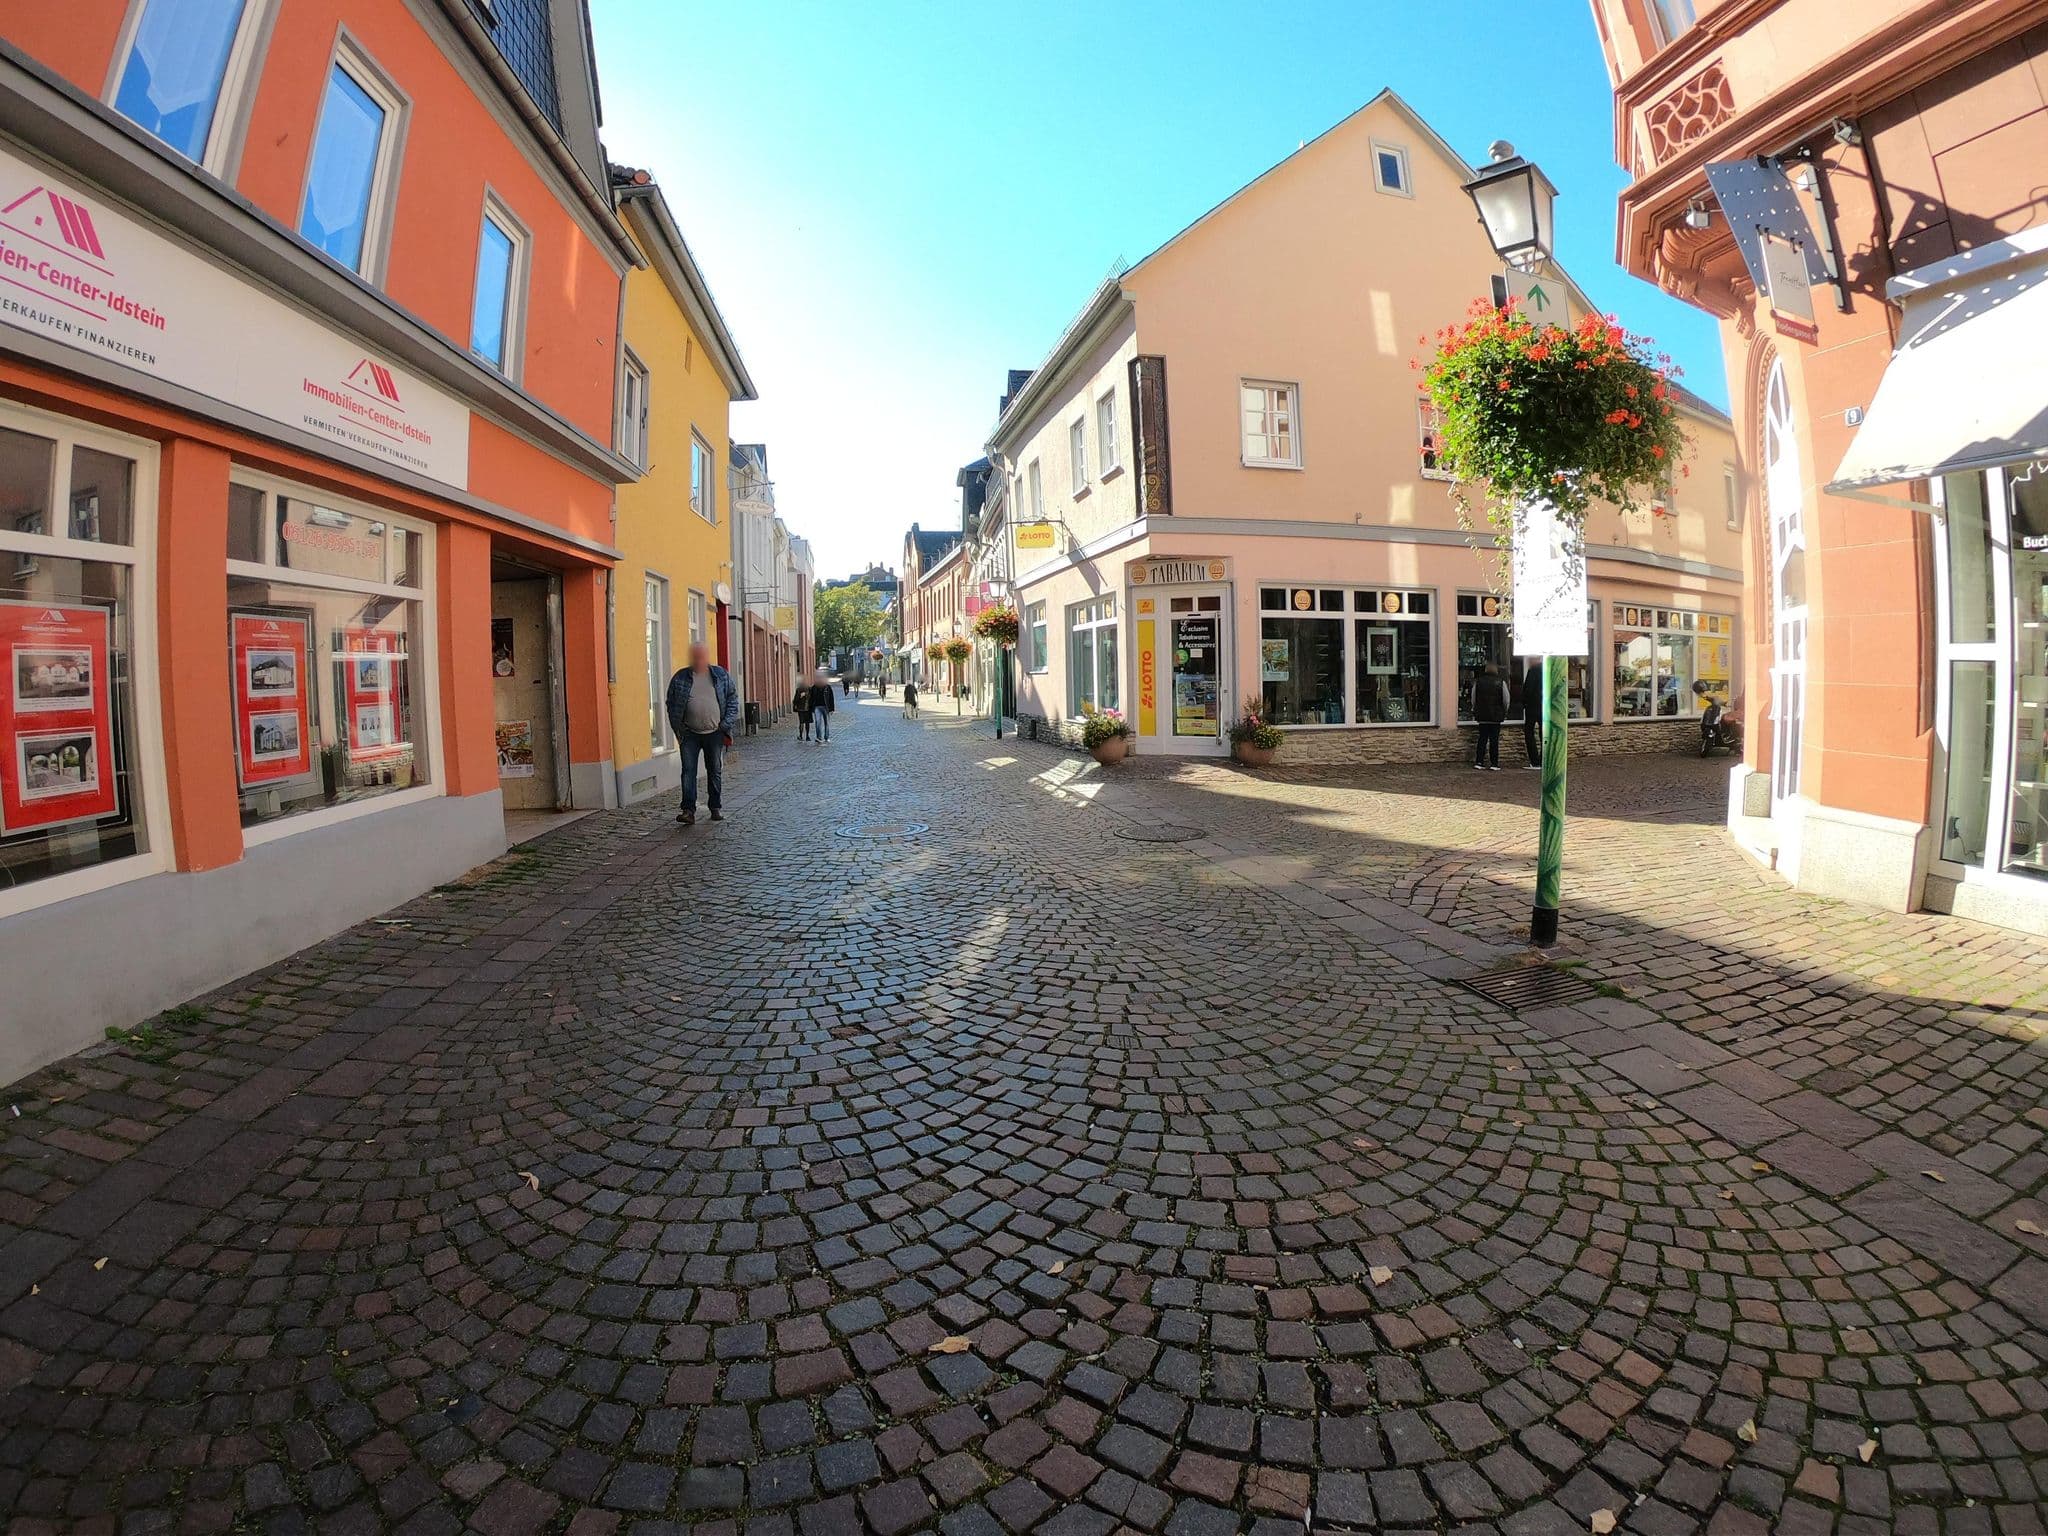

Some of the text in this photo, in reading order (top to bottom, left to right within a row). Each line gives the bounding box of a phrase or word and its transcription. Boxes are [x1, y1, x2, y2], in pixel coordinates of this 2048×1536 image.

[303, 378, 432, 446] Immobilien-Center-Idstein
[1029, 532, 1051, 540] LOTTO
[1150, 562, 1206, 583] TABAKUM
[1142, 650, 1153, 692] LOTTO
